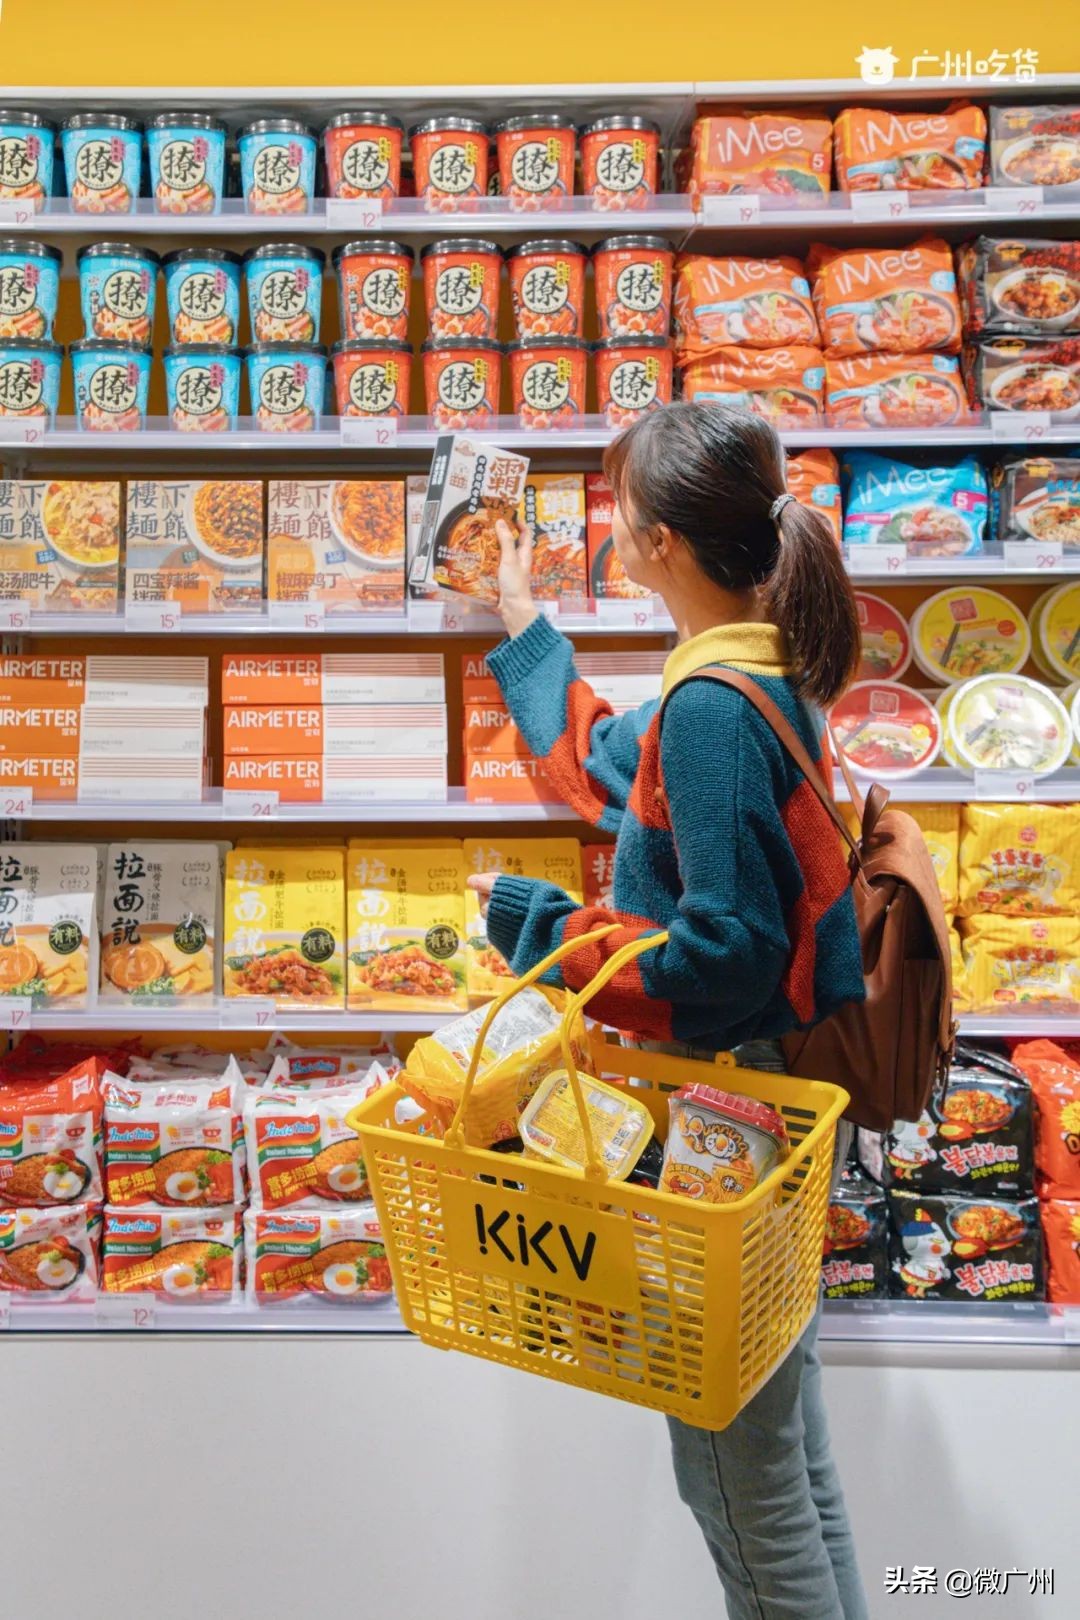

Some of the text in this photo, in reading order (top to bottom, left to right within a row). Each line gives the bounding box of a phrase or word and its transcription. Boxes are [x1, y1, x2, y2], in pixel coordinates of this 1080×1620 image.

[715, 121, 804, 163] iMee
[856, 116, 949, 155] iMee
[812, 153, 824, 171] 5
[834, 250, 922, 295] iMee
[128, 482, 190, 509] 樓下
[269, 482, 331, 509] 樓下
[226, 659, 318, 677] AIRMETER
[227, 710, 320, 728] AIRMETER
[226, 760, 320, 779] AIRMETER
